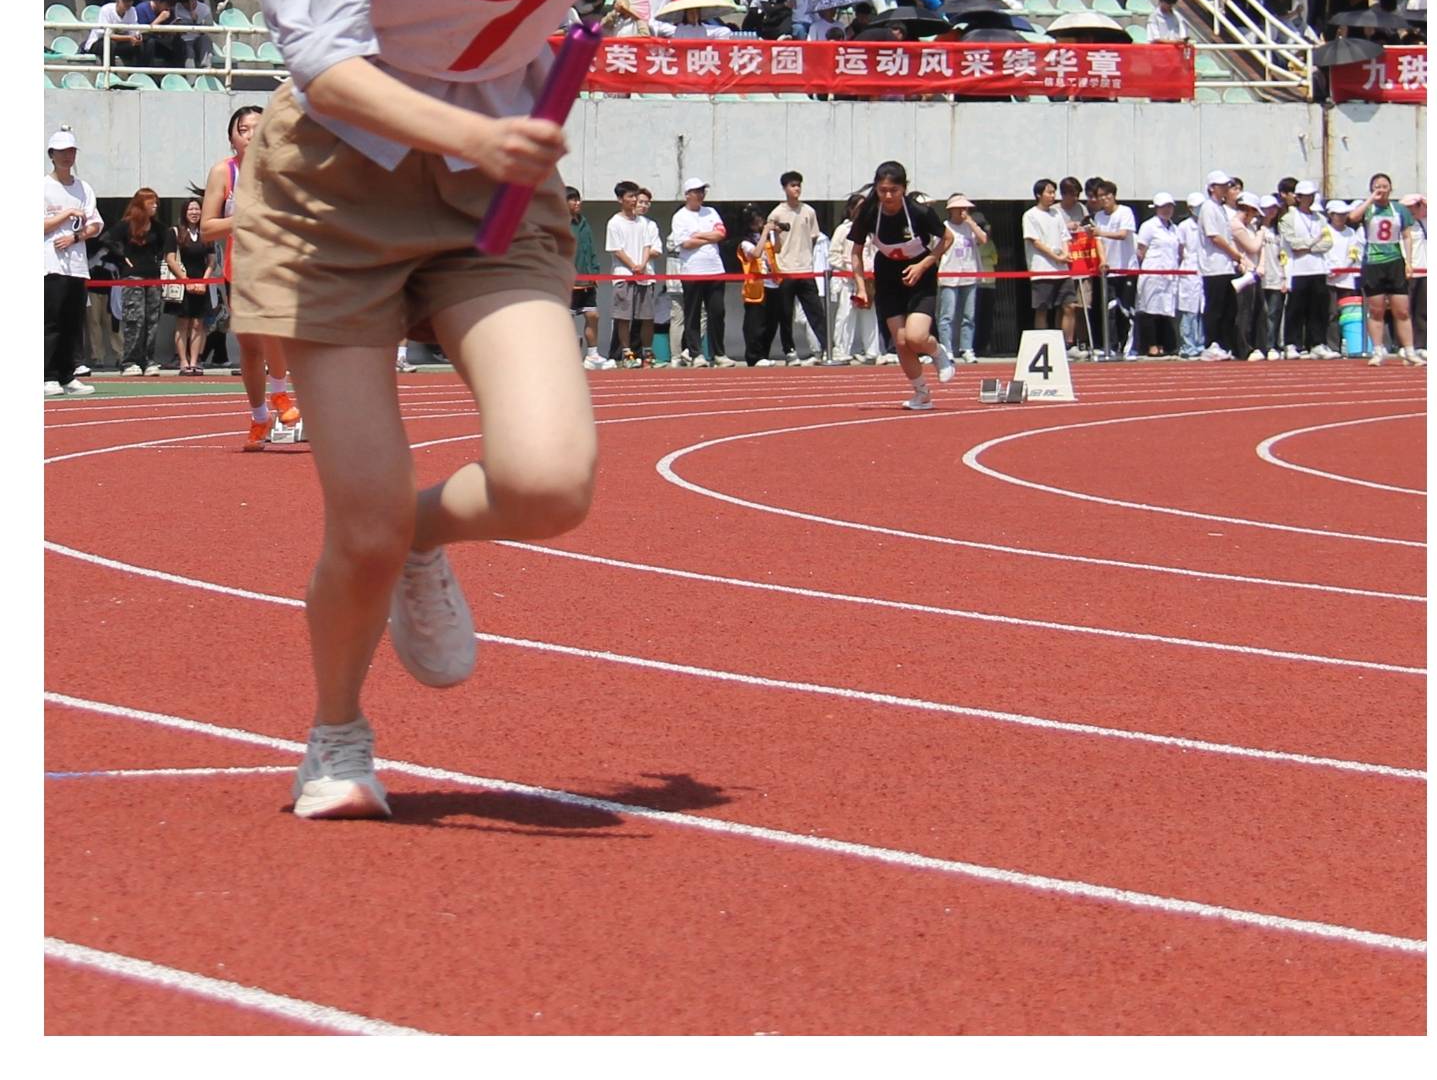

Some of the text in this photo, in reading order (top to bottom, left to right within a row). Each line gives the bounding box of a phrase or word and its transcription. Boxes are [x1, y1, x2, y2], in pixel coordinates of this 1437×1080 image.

[588, 44, 1122, 78] 荣光映校园 运动风采续华章
[1377, 219, 1393, 241] 8
[1028, 342, 1054, 381] 4
